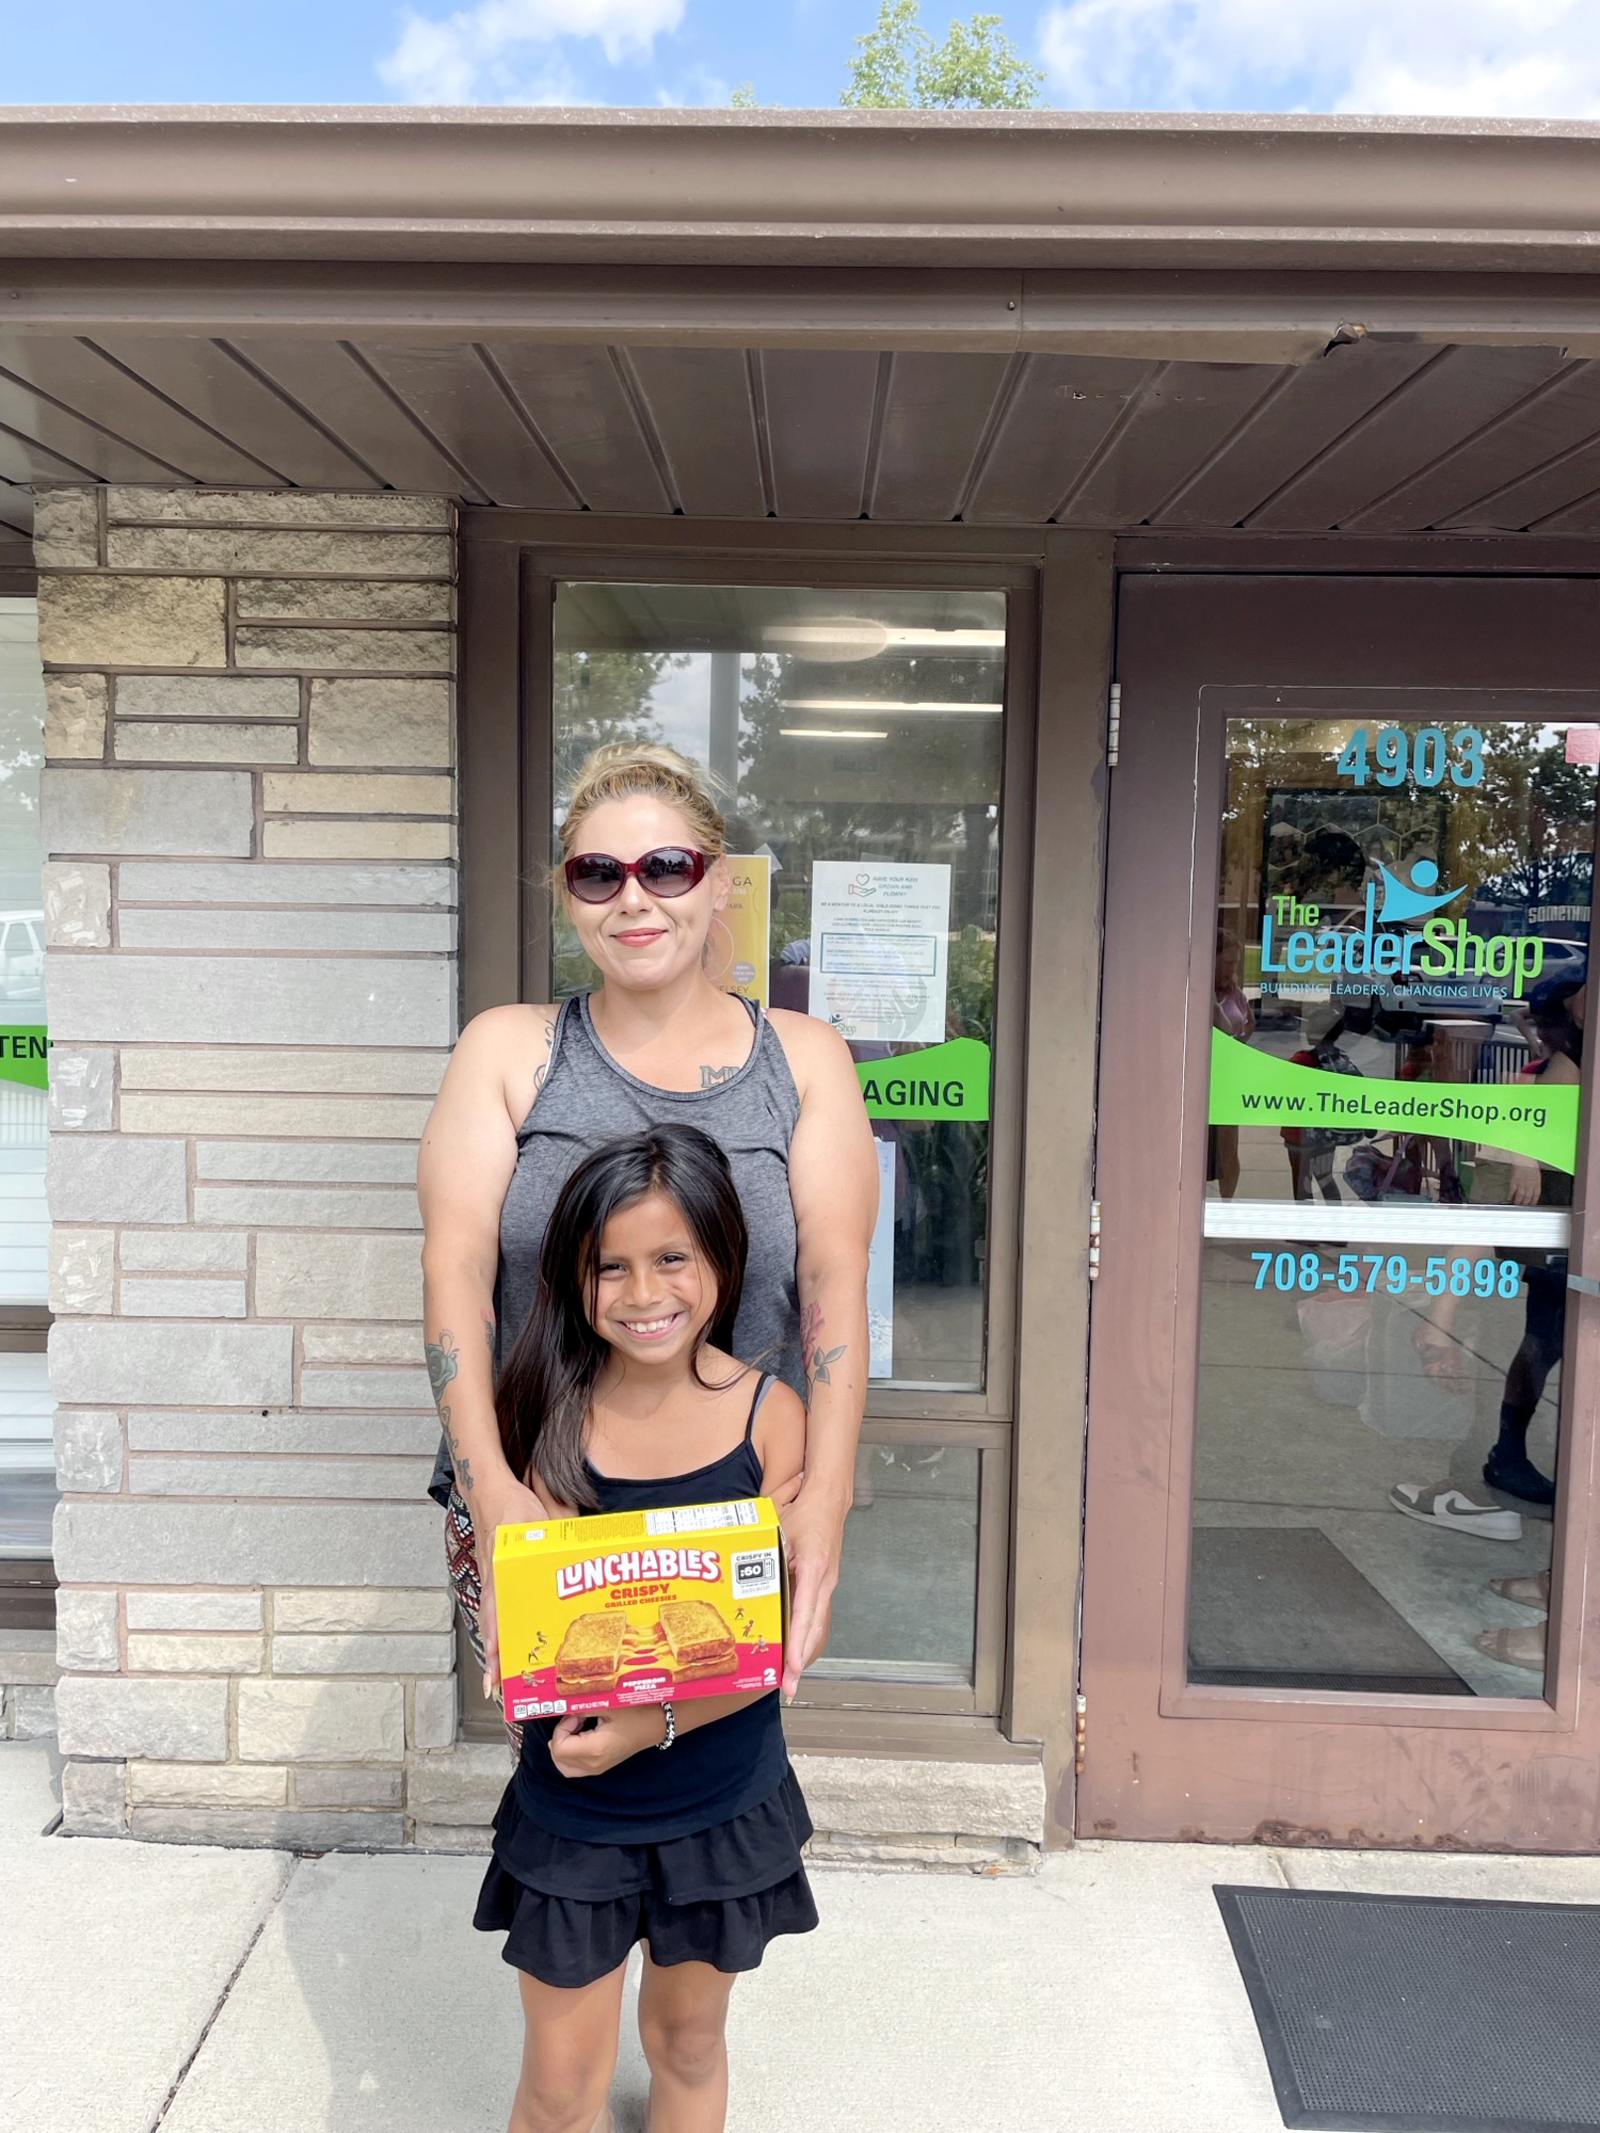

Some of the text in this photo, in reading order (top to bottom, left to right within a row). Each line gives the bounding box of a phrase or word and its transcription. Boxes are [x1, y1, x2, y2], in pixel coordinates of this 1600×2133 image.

[1337, 727, 1484, 788] 4903
[727, 902, 744, 910] ARK
[1272, 895, 1320, 927] The
[1260, 881, 1544, 998] LeaderShop
[717, 985, 750, 995] ELSEY
[1259, 981, 1508, 998] BUILDING LEADERS, CHANGING LIVES
[863, 1079, 965, 1107] AGING
[1241, 1091, 1547, 1128] www.TheLeaderShop.org
[1250, 1251, 1520, 1299] 708-579-5898
[736, 1553, 763, 1561] CRISPY
[556, 1548, 721, 1600] LUNCHABLES
[739, 1564, 762, 1578] :60
[610, 1583, 671, 1600] CRISPY
[604, 1594, 677, 1608] GRILLED CHEESIES
[623, 1676, 666, 1687] PEPPERONI
[763, 1667, 777, 1681] 2
